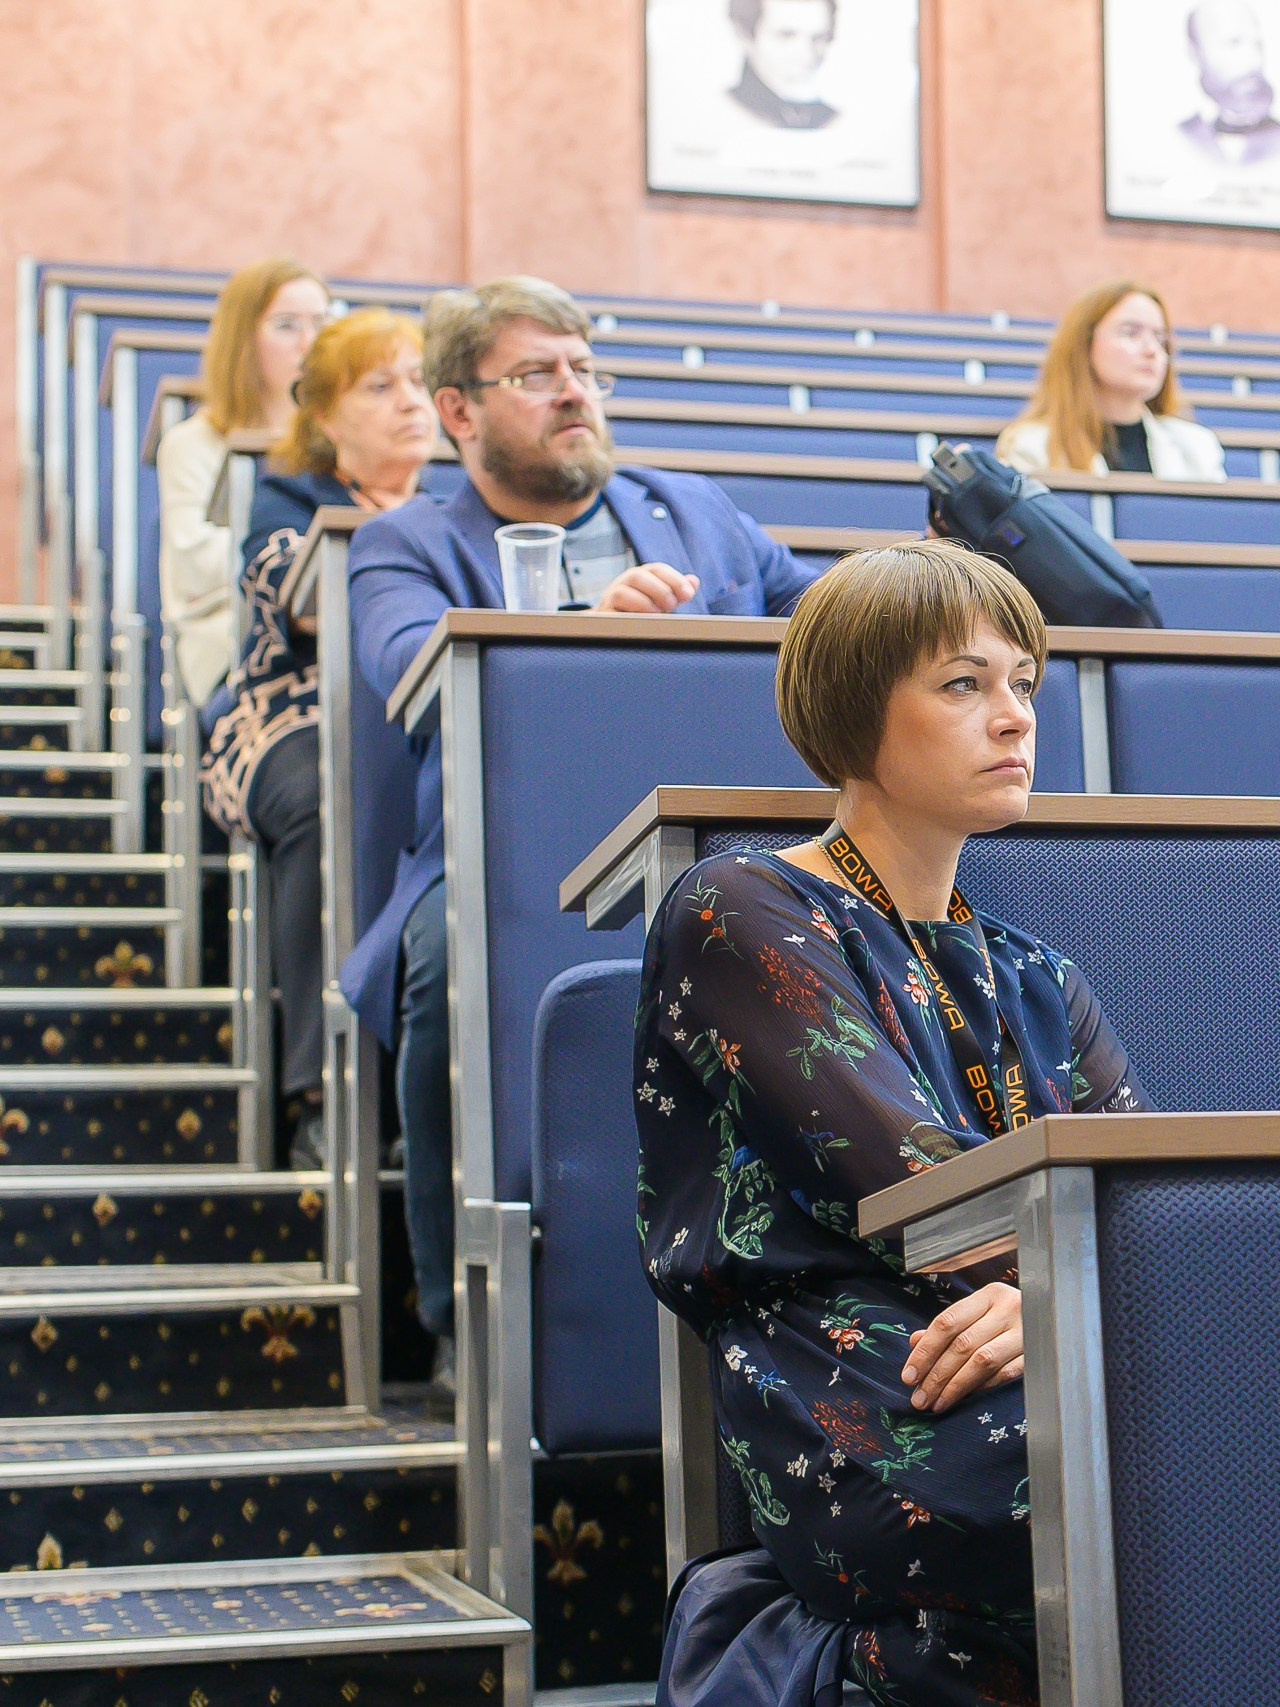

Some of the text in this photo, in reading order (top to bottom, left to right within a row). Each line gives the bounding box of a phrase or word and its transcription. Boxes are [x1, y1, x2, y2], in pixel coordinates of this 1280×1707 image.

[829, 837, 893, 911] BOWA
[912, 939, 965, 1030] BOWA
[966, 1064, 1005, 1135] BOW
[1005, 1063, 1029, 1132] OWA
